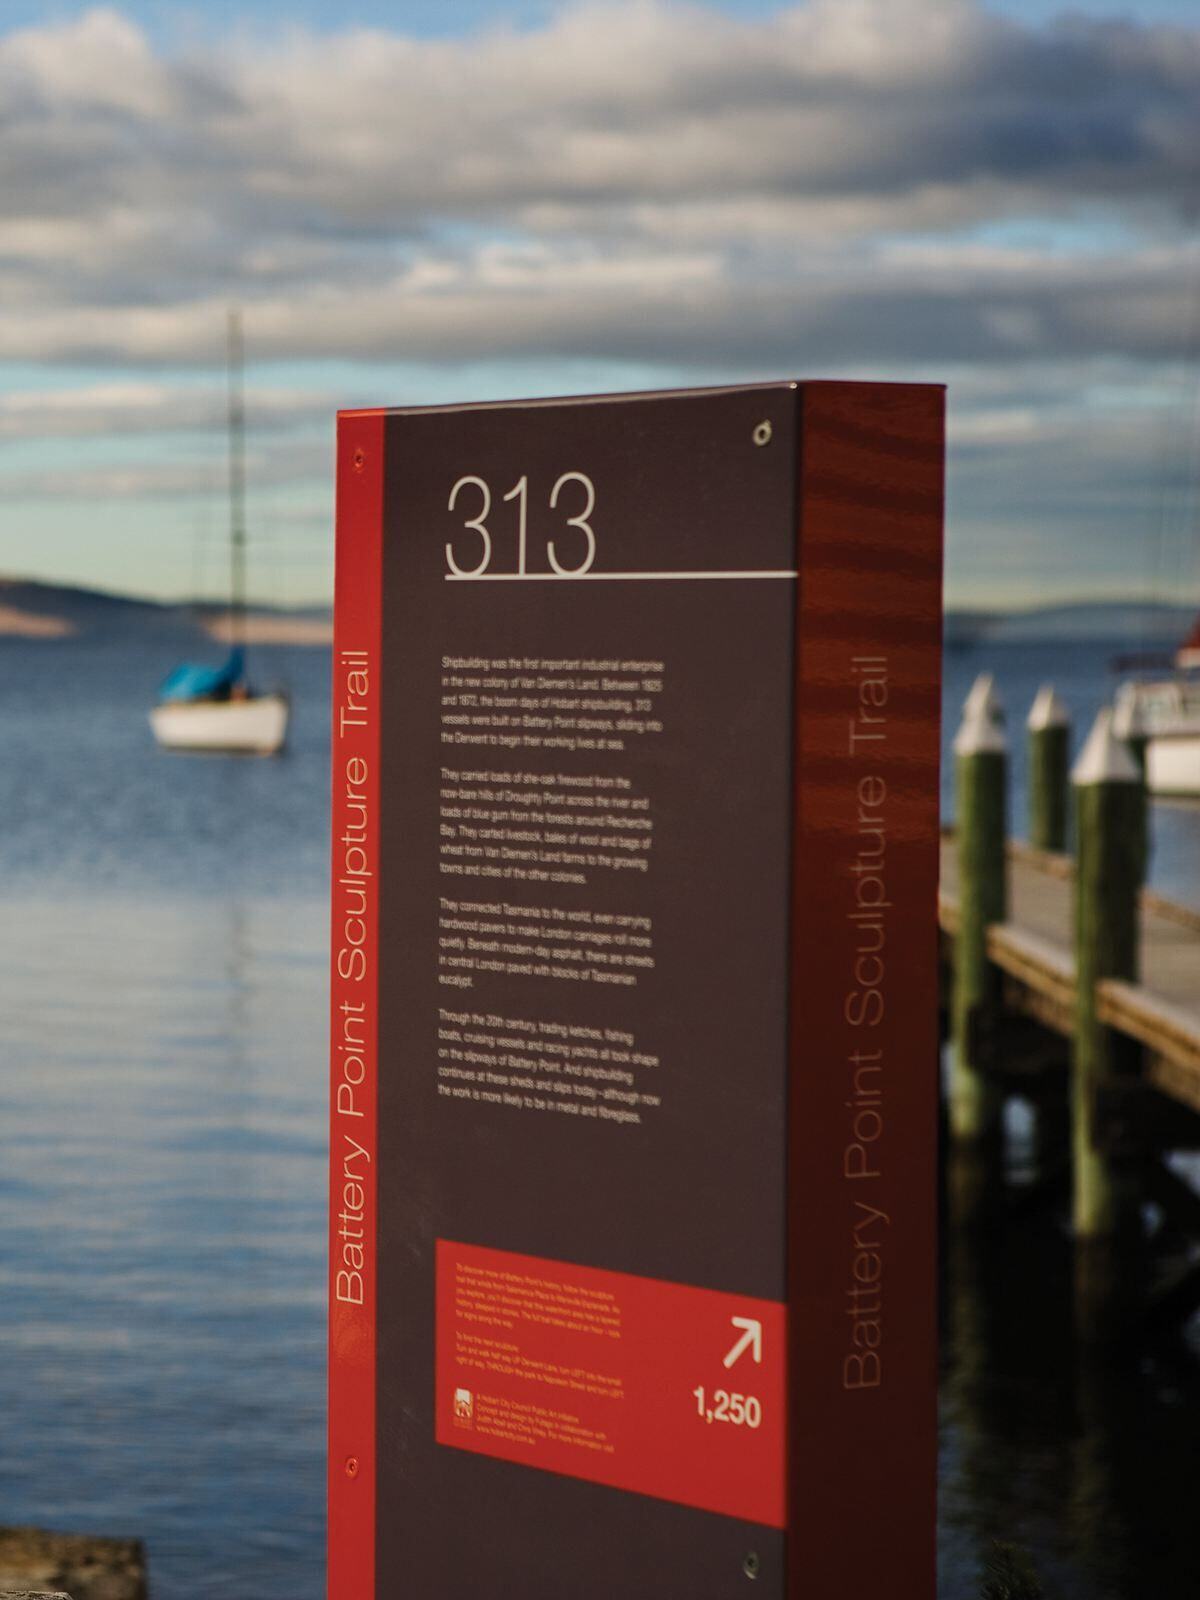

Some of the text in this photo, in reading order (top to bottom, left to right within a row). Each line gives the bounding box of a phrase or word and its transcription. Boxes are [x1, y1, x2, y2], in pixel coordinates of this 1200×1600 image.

[446, 471, 596, 576] 313
[336, 651, 373, 1305] Battery Point Sculpture Trail
[843, 655, 893, 1390] Battery Point Sculpture Trail
[693, 1385, 762, 1428] 1,250
